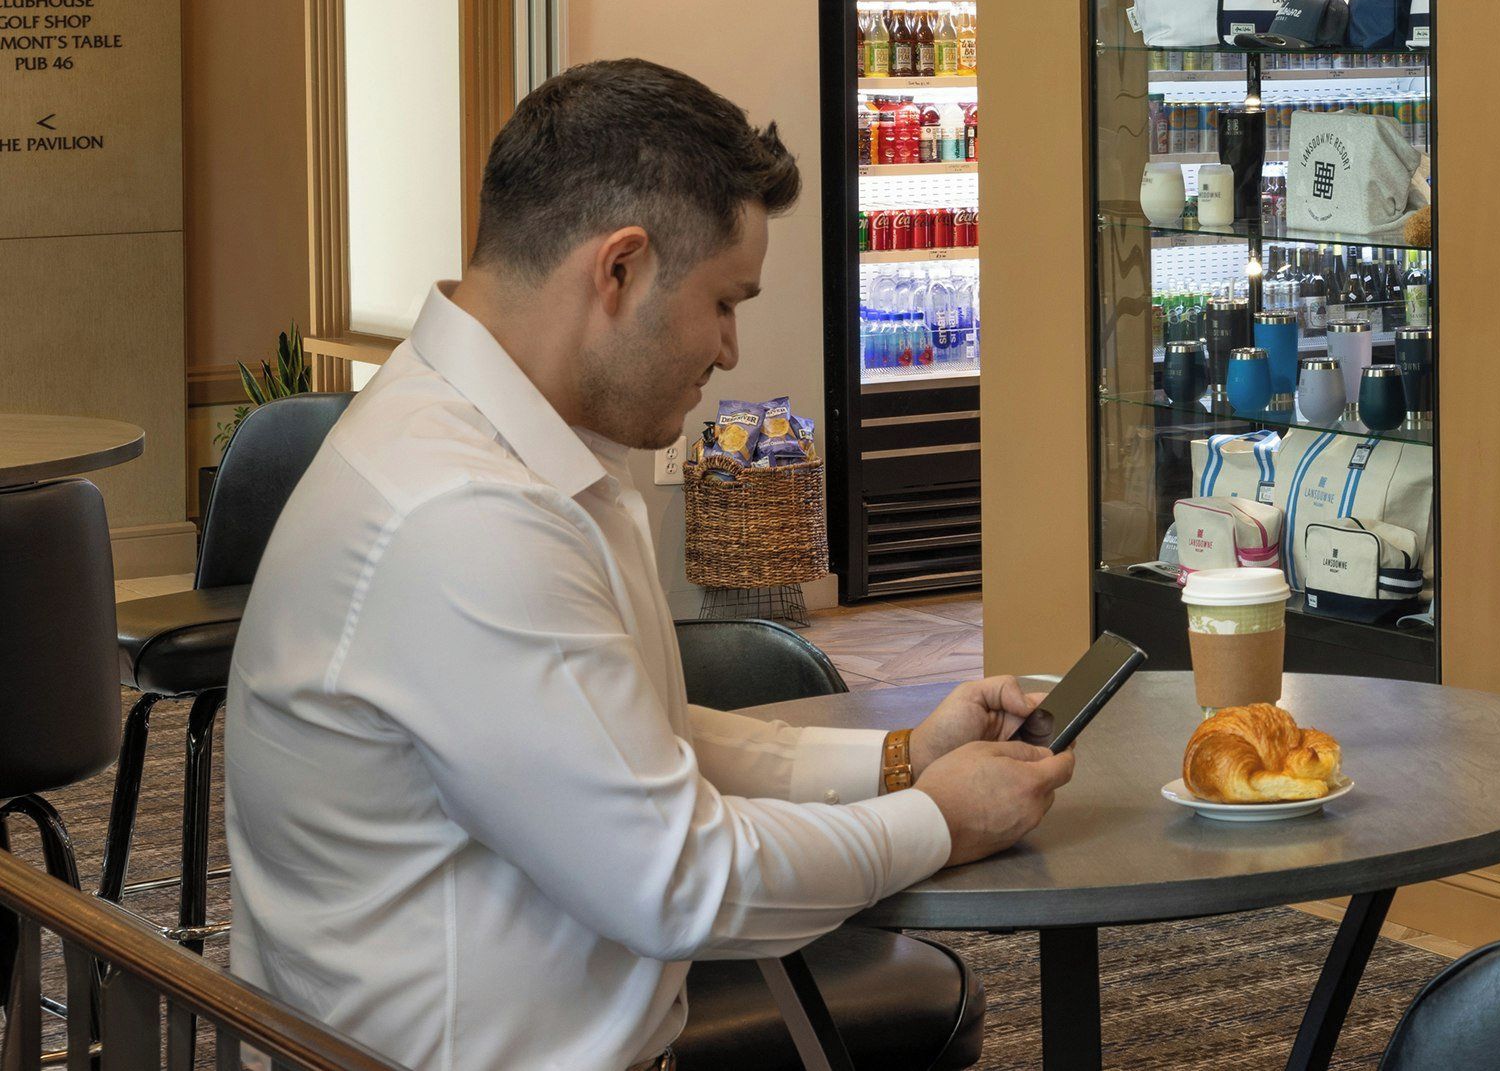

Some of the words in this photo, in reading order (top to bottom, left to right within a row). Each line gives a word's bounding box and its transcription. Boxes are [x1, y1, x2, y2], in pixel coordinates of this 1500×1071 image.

[44, 15, 92, 29] SHOP
[72, 34, 123, 49] TABLE
[15, 56, 48, 71] PUB
[53, 56, 74, 70] 46
[27, 135, 104, 152] PAVILION
[1300, 132, 1334, 168] LANSDOWNE
[1333, 137, 1351, 171] RESORT
[1304, 488, 1336, 504] LANSDOWNE
[1188, 538, 1214, 550] LANSDOWNE
[1322, 558, 1348, 570] LANSDOWNE
